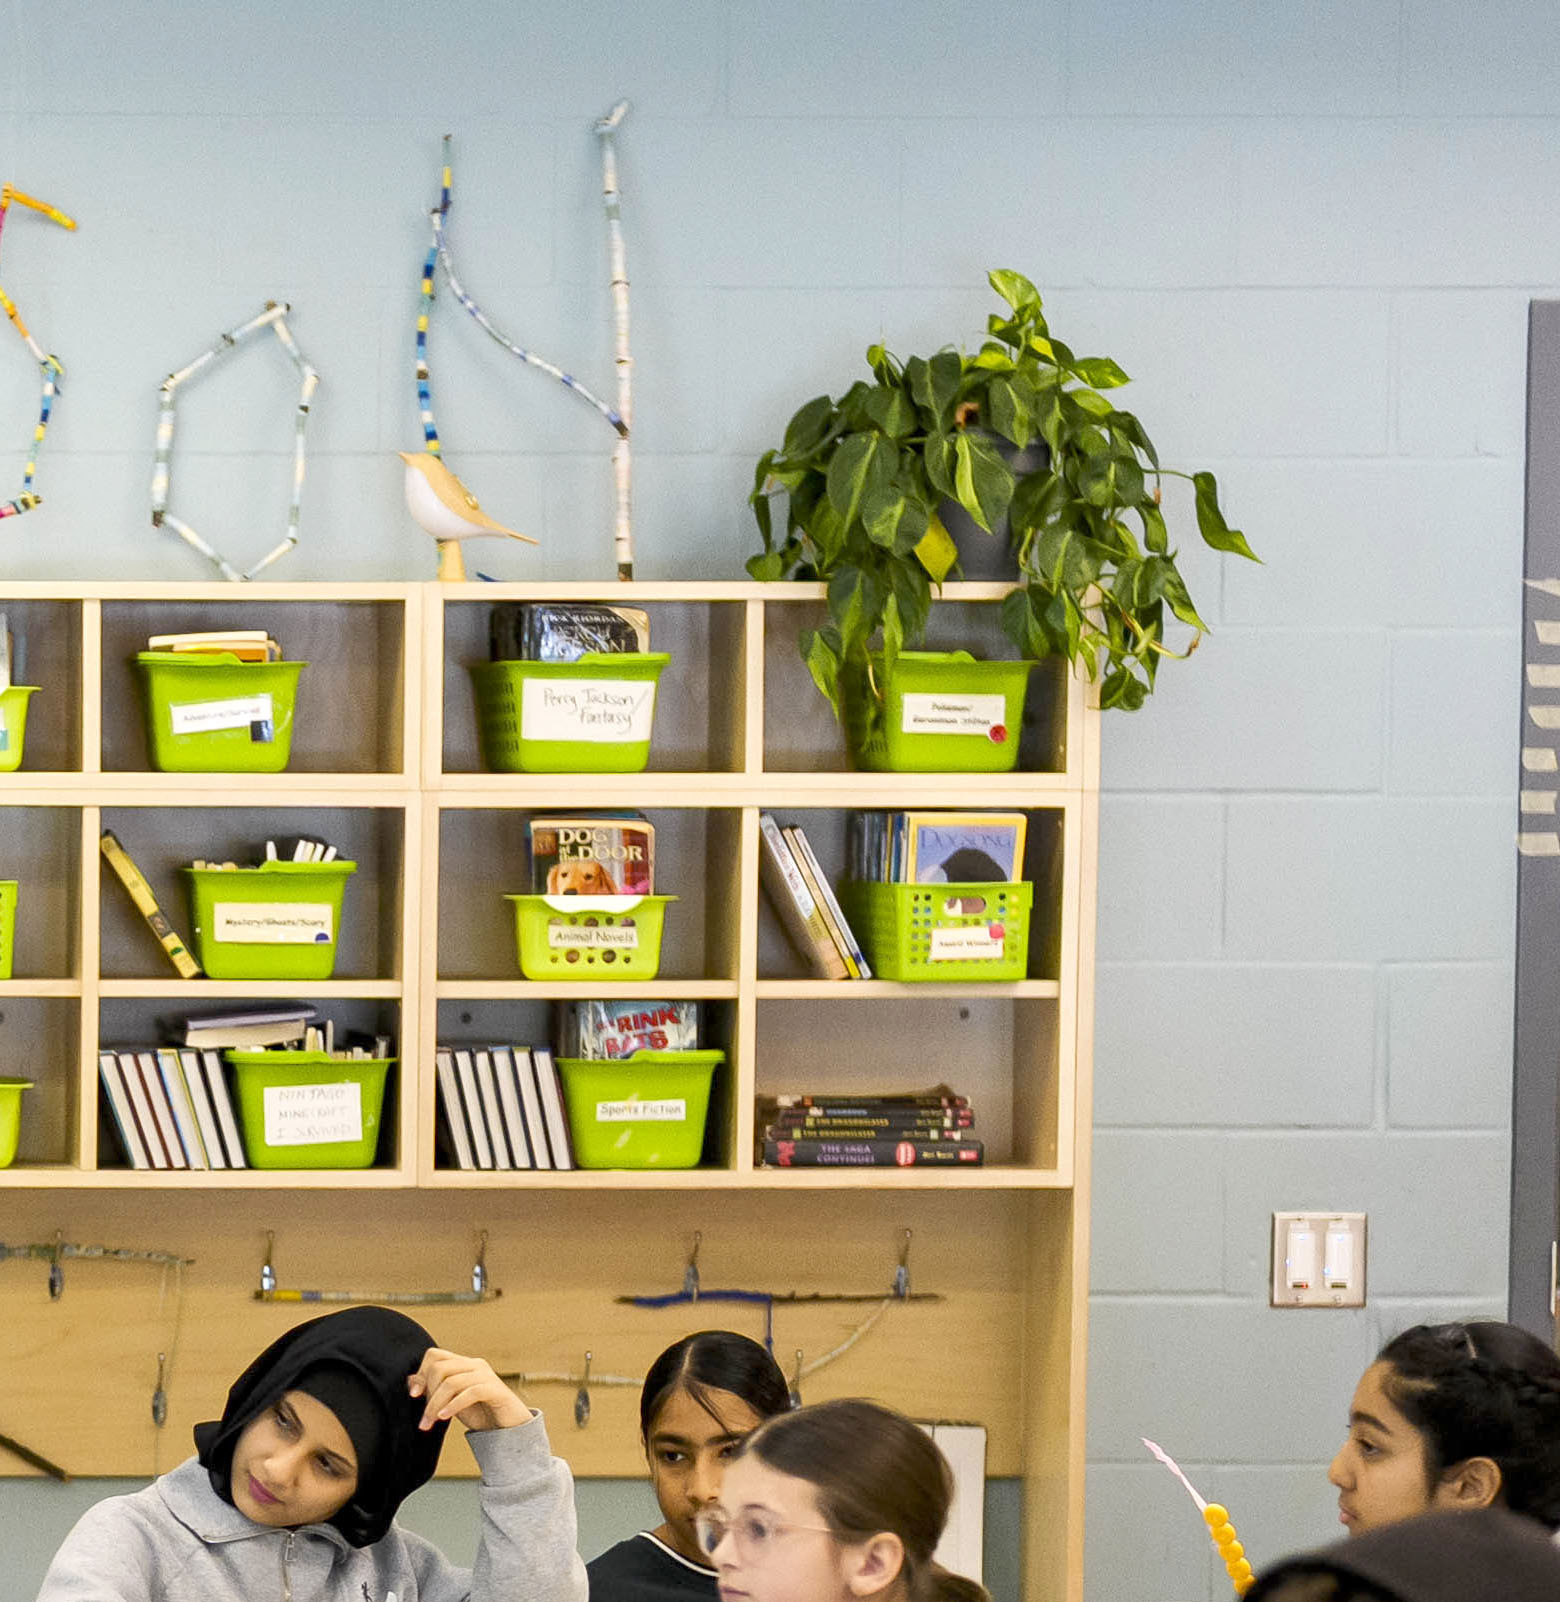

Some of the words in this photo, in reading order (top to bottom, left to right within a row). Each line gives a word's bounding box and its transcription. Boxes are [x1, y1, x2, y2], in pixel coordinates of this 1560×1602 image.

[543, 687, 577, 710] Percy
[580, 686, 634, 704] Jackson
[559, 828, 607, 846] DOG
[921, 829, 1012, 849] DOGSONG
[578, 845, 644, 861] DOOR
[554, 930, 593, 942] Animal
[595, 930, 634, 942] Novels
[601, 1103, 639, 1116] Sports
[642, 1101, 682, 1113] Fiction
